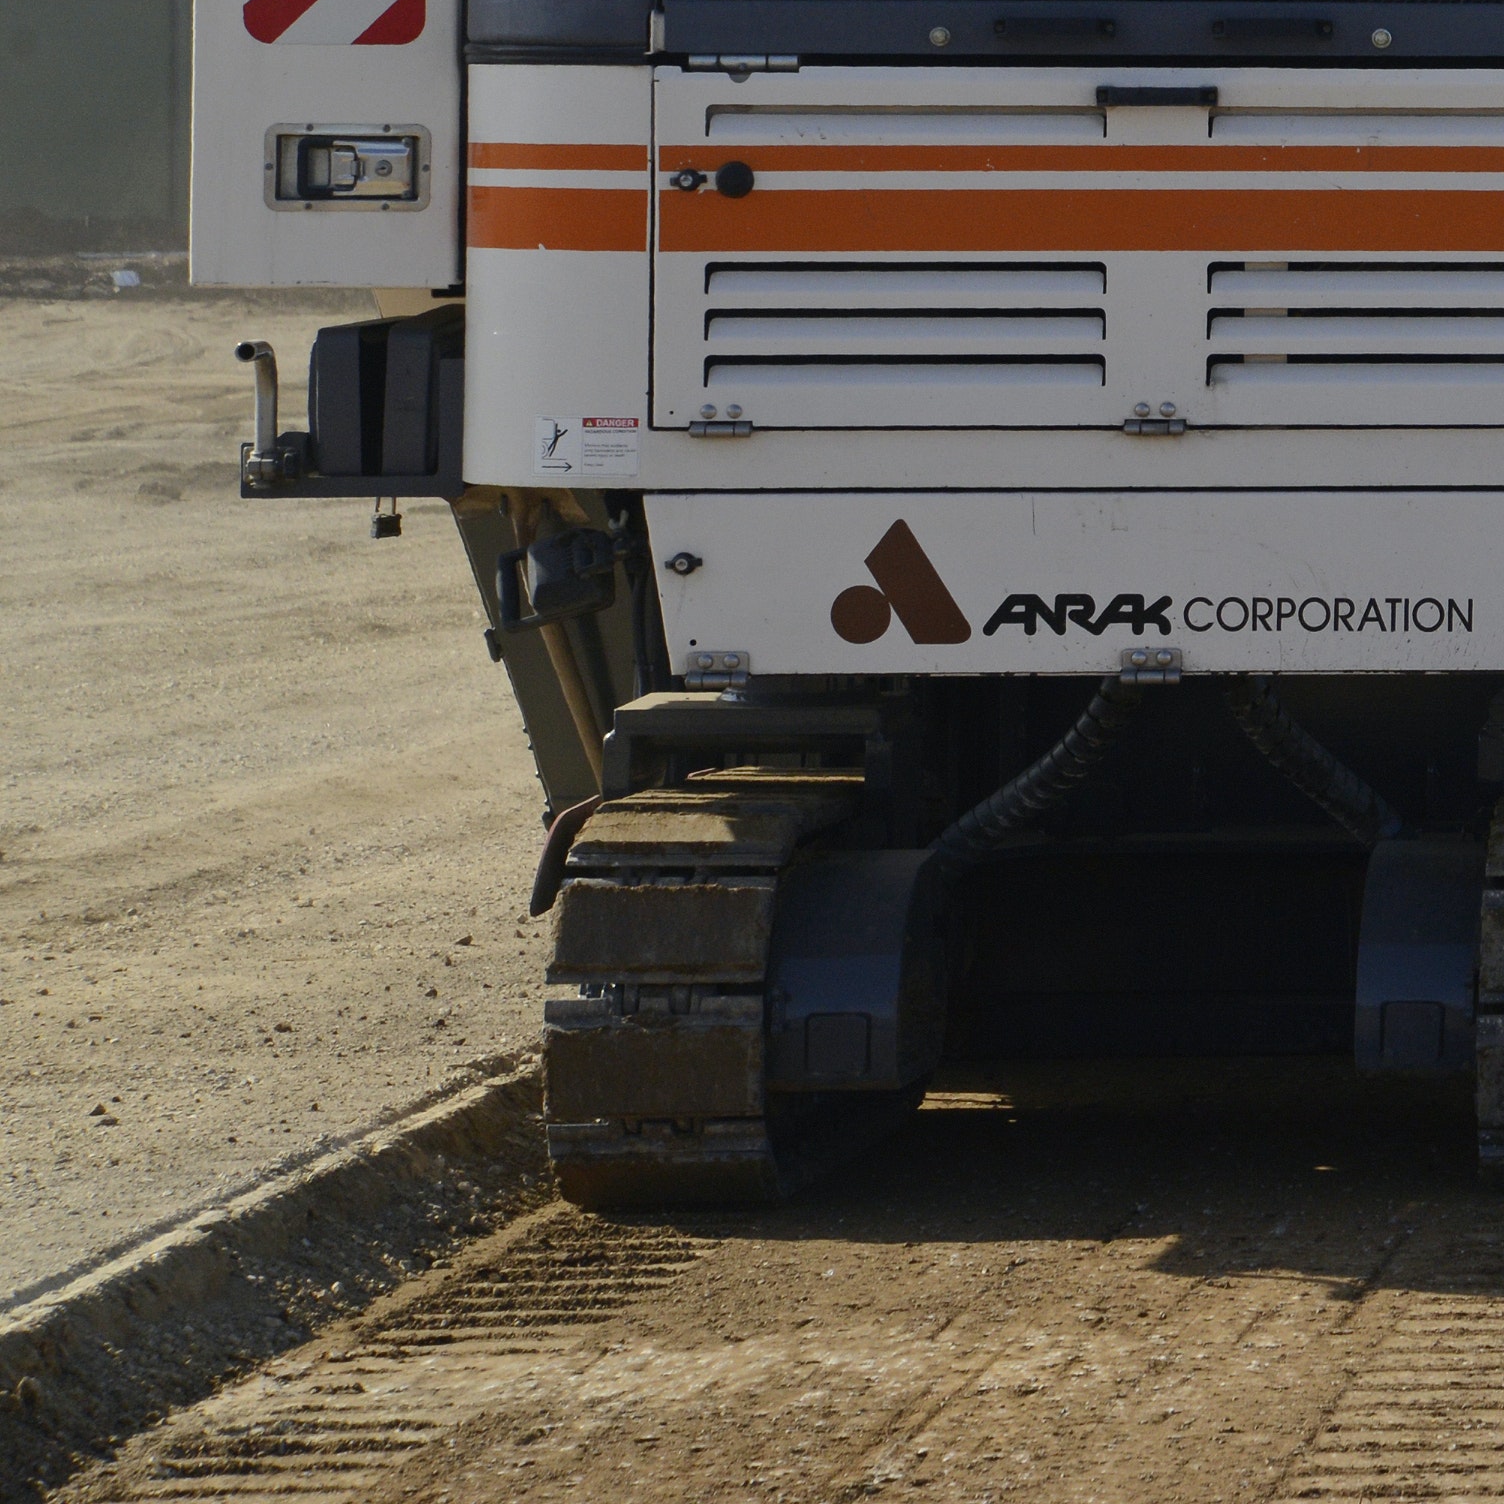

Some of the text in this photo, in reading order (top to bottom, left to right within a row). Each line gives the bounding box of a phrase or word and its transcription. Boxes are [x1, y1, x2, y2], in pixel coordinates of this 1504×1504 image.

[596, 419, 635, 427] DANGER
[982, 593, 1474, 636] ANRAK CORPORATION
